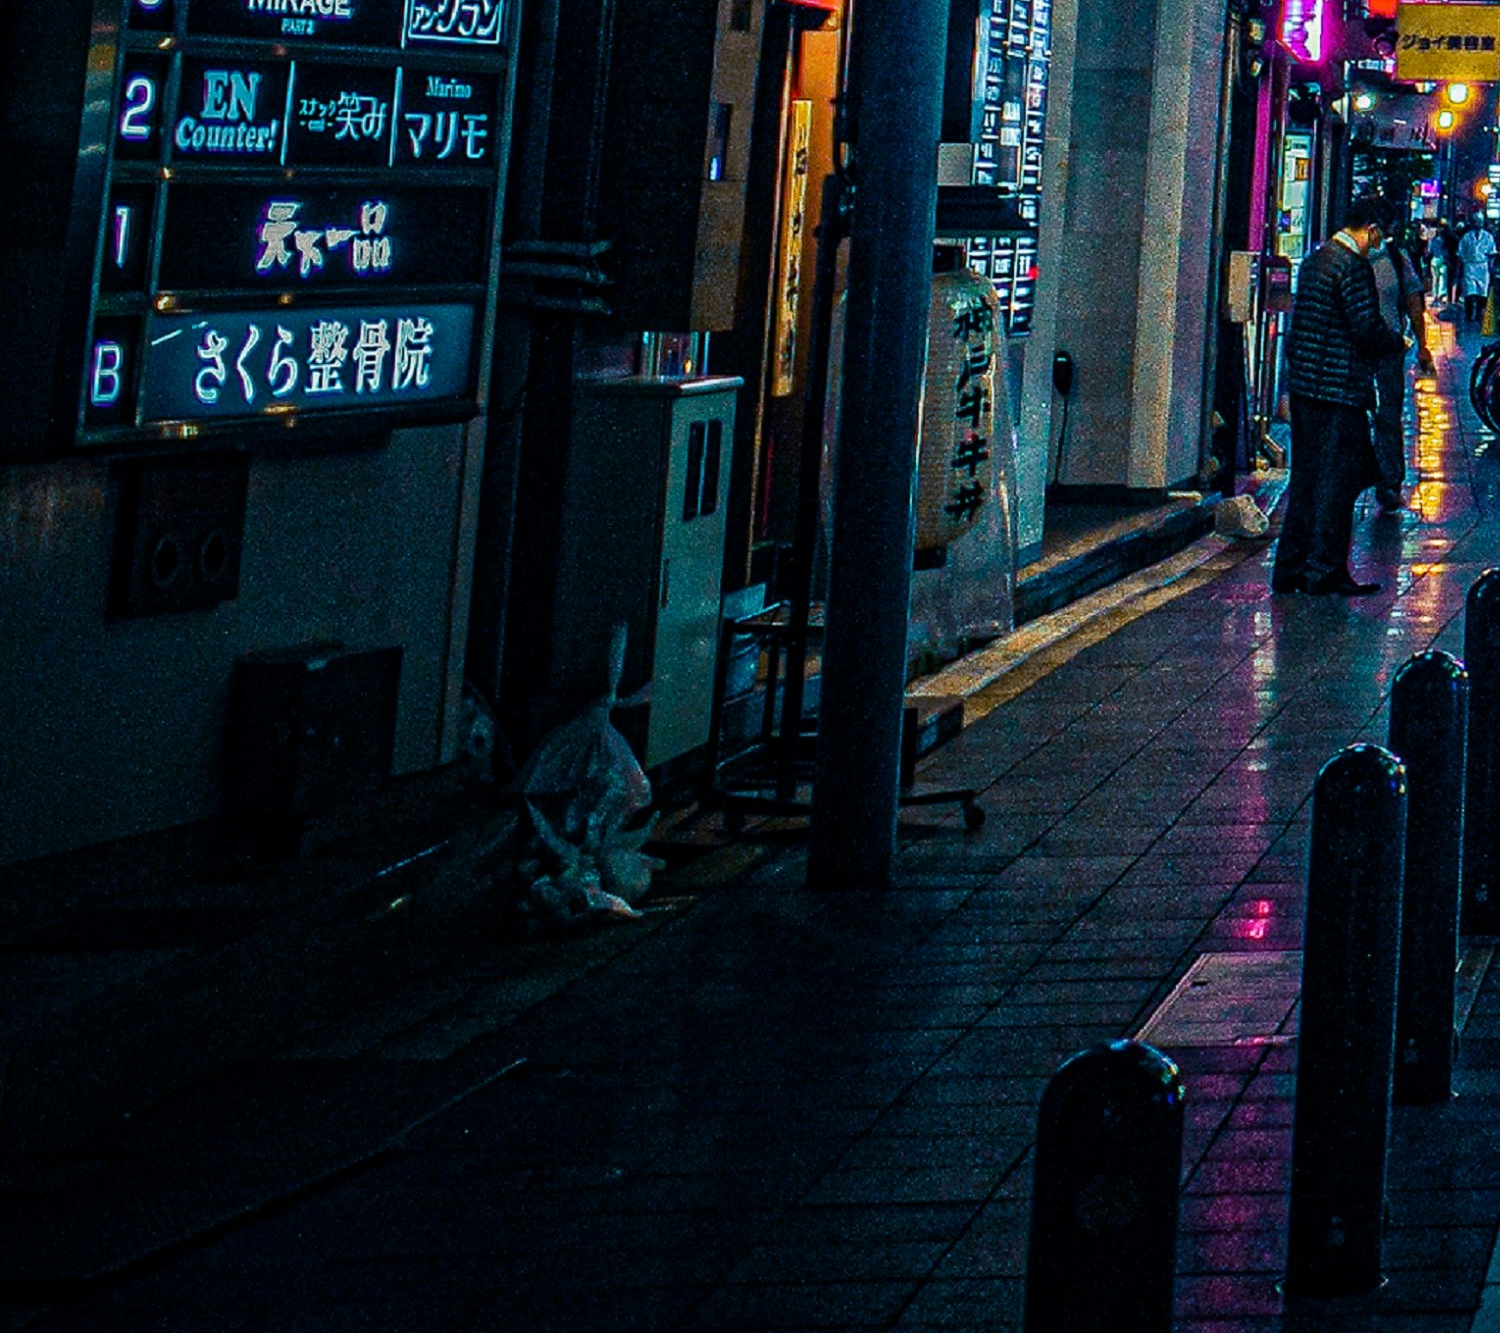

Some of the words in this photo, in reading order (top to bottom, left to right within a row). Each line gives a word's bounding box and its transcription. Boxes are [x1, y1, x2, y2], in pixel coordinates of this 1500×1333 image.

[121, 77, 154, 138] 2
[202, 70, 262, 121] EN
[337, 91, 387, 140] 笑み
[175, 115, 278, 152] Counter!
[404, 114, 488, 158] マリモ
[115, 205, 129, 267] 1
[255, 202, 390, 277] 天下一品
[92, 343, 124, 406] B
[196, 319, 434, 404] さくら整骨院
